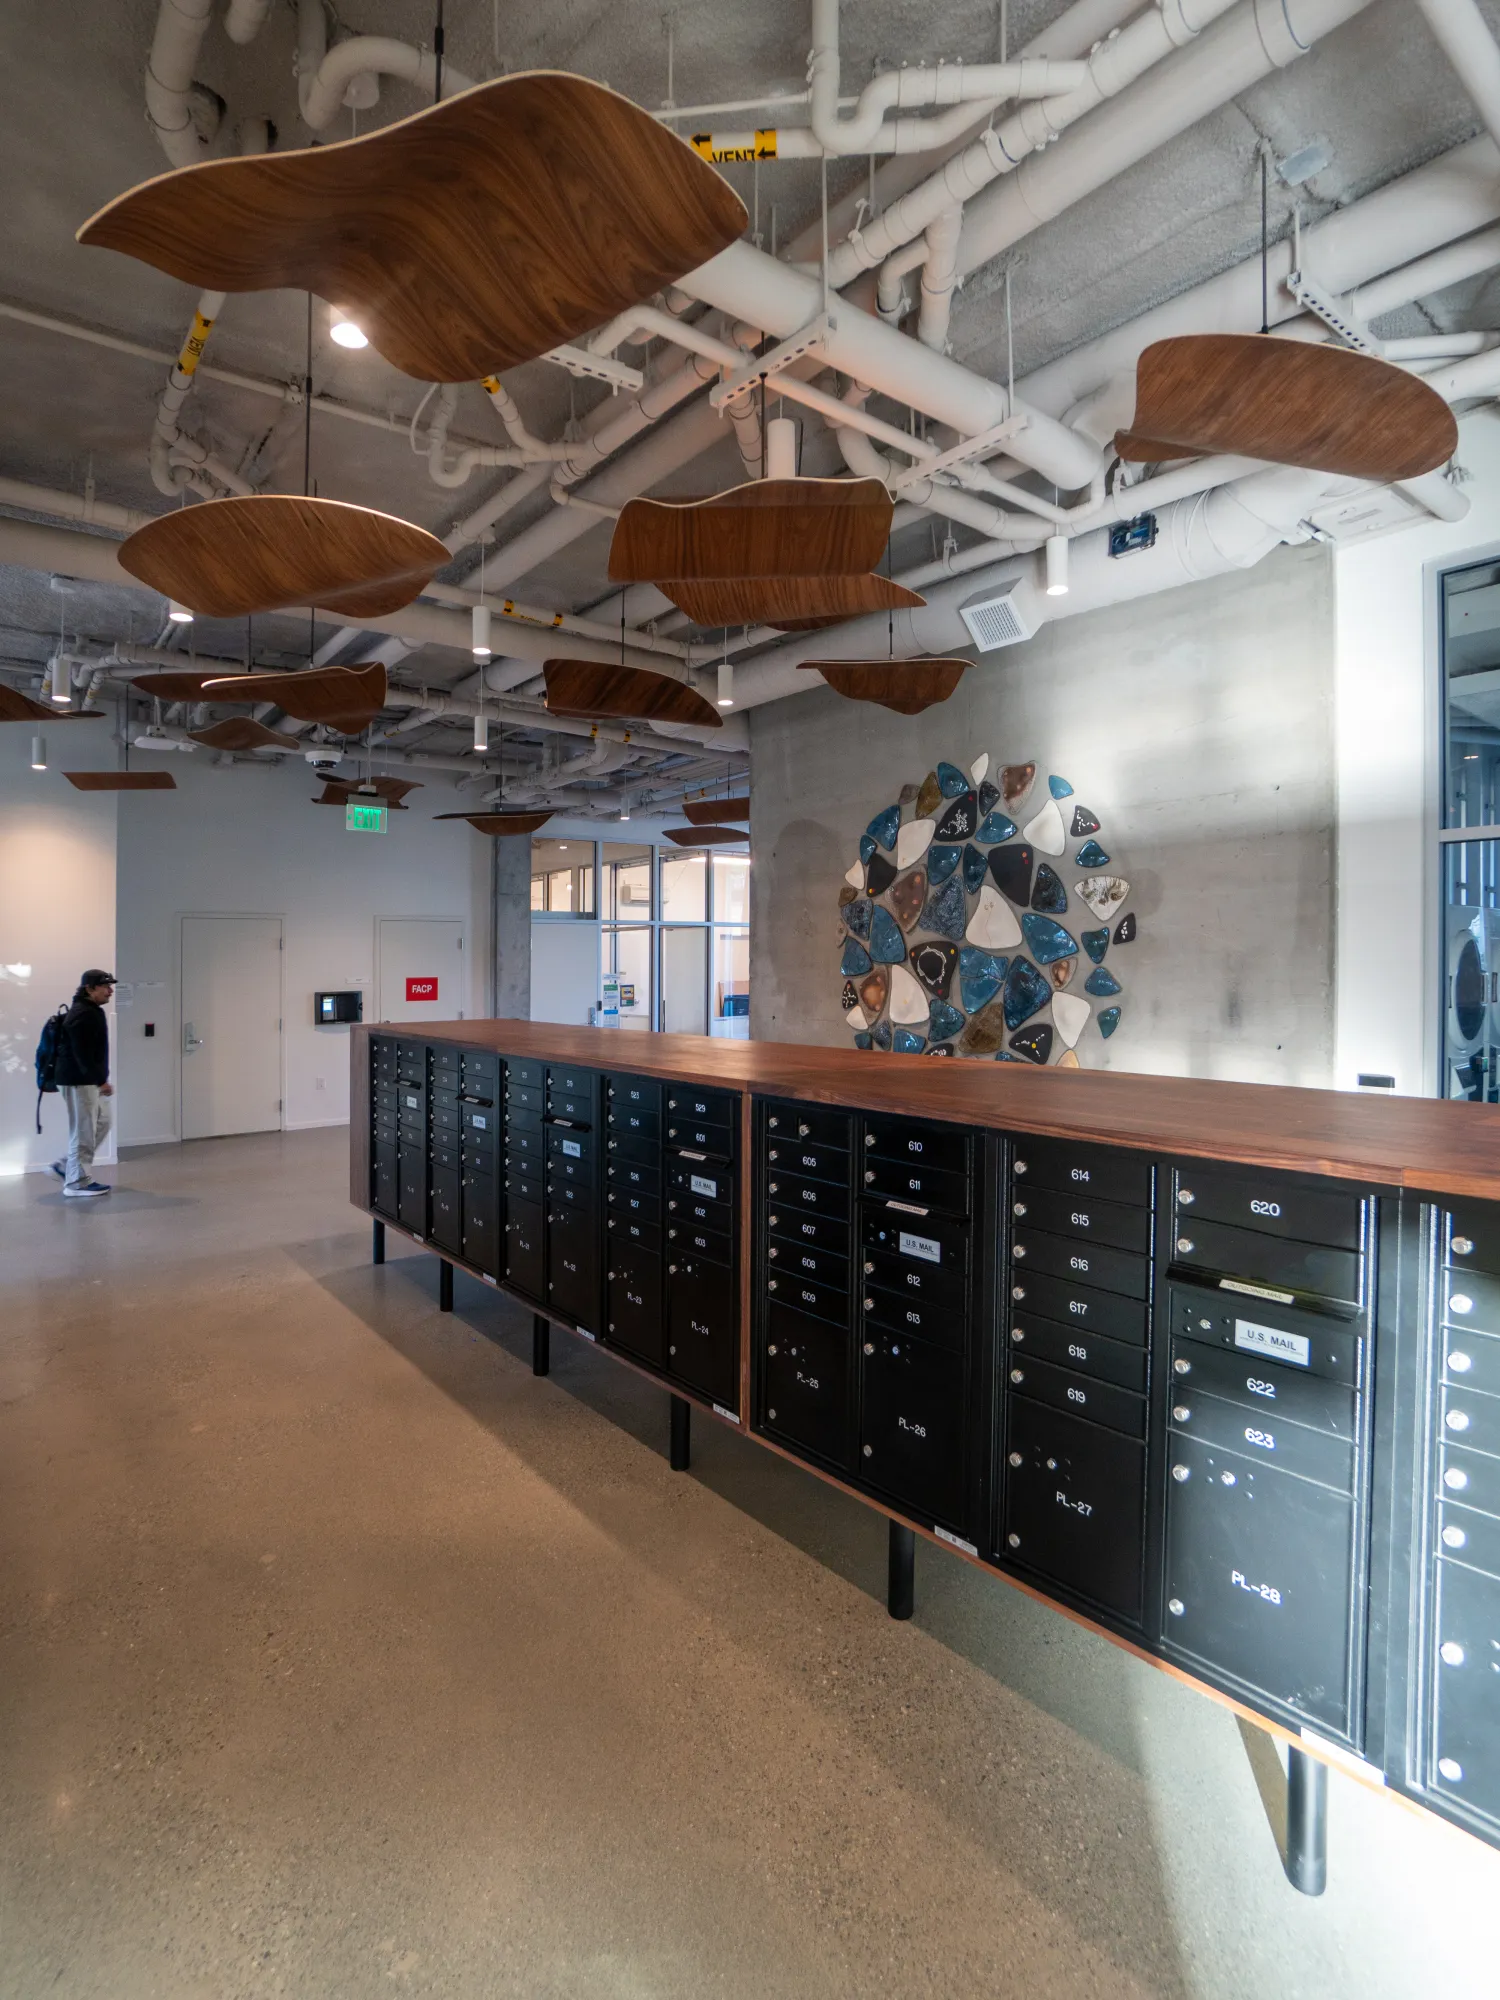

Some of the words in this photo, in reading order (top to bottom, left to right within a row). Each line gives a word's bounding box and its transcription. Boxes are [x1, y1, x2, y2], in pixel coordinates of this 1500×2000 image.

[711, 148, 756, 163] VENT
[353, 807, 382, 830] EXIT
[411, 984, 433, 994] FACP
[695, 1103, 706, 1113] 529
[695, 1132, 706, 1143] 601
[907, 1140, 922, 1152] 610
[802, 1155, 817, 1167] 605
[1070, 1168, 1089, 1182] 614
[908, 1178, 922, 1191] 611
[802, 1189, 817, 1202] 606
[694, 1206, 706, 1218] 602
[1250, 1199, 1280, 1216] 620
[1070, 1212, 1089, 1226] 615
[802, 1223, 816, 1236] 607
[694, 1236, 706, 1248] 603
[905, 1239, 918, 1248] U.S.
[919, 1242, 934, 1252] MAIL
[801, 1257, 816, 1270] 608
[1069, 1256, 1088, 1271] 616
[906, 1273, 921, 1287] 612
[801, 1290, 816, 1303] 609
[1227, 1282, 1265, 1295] OUTGOING
[1266, 1291, 1283, 1300] MAIL
[1068, 1300, 1087, 1315] 617
[906, 1311, 921, 1325] 613
[691, 1320, 708, 1335] PL-24
[1247, 1329, 1268, 1343] U.S.
[1270, 1336, 1297, 1351] MAIL
[1068, 1344, 1086, 1360] 618
[796, 1371, 818, 1388] PL-25
[1246, 1377, 1275, 1398] 622
[1066, 1387, 1085, 1403] 619
[898, 1416, 926, 1437] PL-26
[1245, 1427, 1275, 1449] 623
[1055, 1490, 1092, 1516] PL-27
[1231, 1569, 1281, 1605] PL-28
